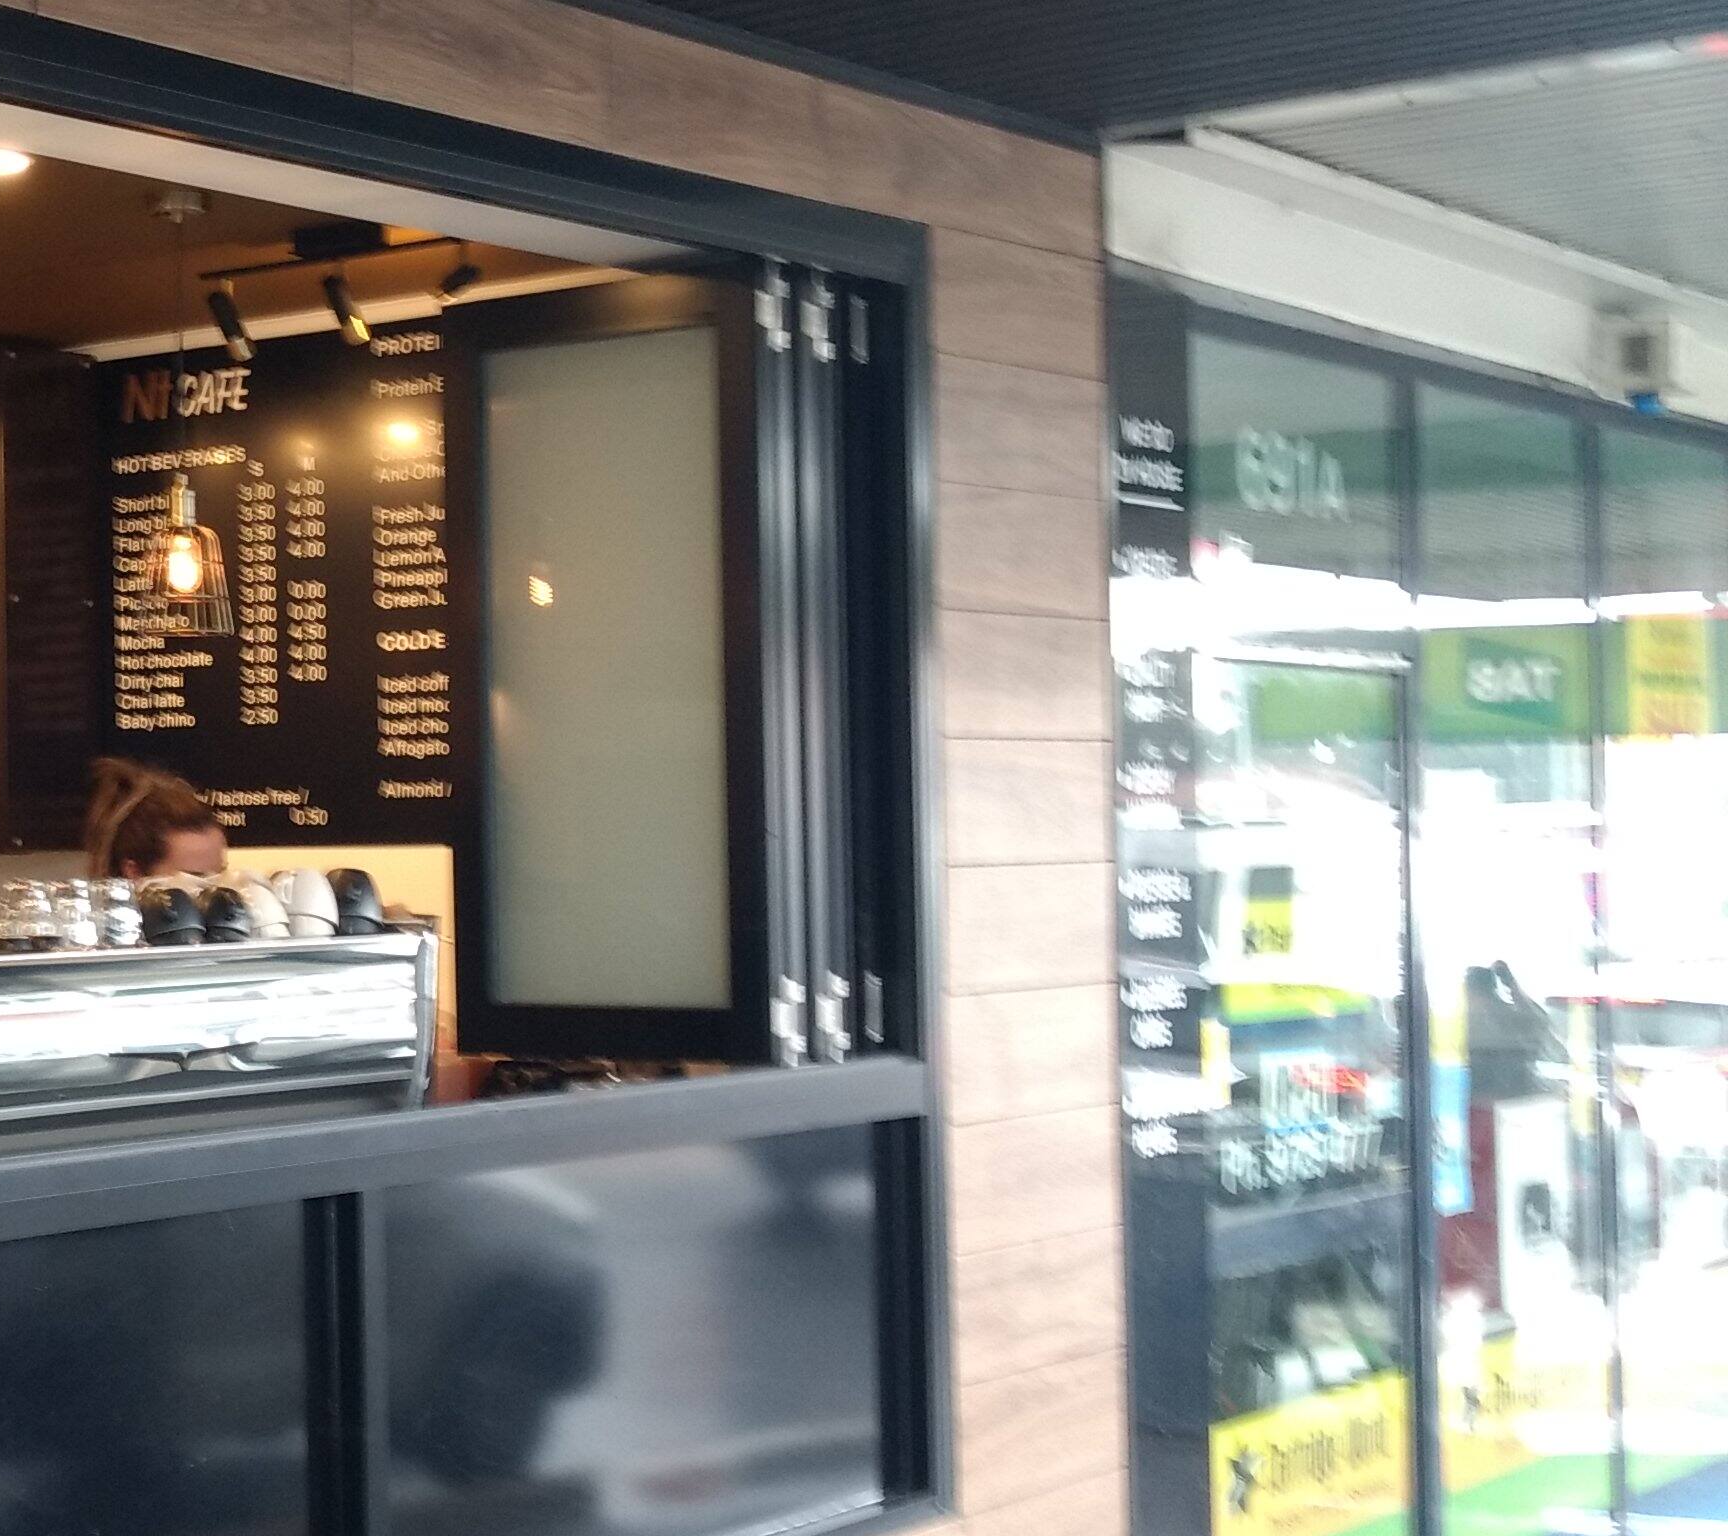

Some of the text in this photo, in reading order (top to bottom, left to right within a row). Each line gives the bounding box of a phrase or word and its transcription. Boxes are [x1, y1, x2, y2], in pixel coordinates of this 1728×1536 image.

[371, 376, 433, 398] Protein
[112, 454, 147, 474] HOT
[113, 494, 154, 514] Short
[237, 483, 275, 501] 3.00
[286, 477, 325, 496] 4.00
[113, 517, 151, 534] Long
[238, 503, 275, 521] 3.50
[286, 499, 325, 517] 4.00
[372, 505, 422, 525] Fresh
[113, 535, 144, 553] Flat
[238, 524, 275, 542] 3.50
[286, 519, 325, 537] 4.00
[373, 527, 436, 546] Orange
[238, 544, 276, 562] 3.50
[286, 539, 325, 558] 4.00
[373, 548, 431, 567] Lemon
[238, 564, 276, 582] 3.50
[238, 584, 276, 602] 3.00
[373, 589, 428, 609] Green
[238, 605, 277, 622] 3.00
[114, 634, 165, 651] Mocha
[239, 625, 277, 643] 4.00
[377, 630, 432, 651] COLD
[115, 643, 326, 670] Hot chocolate 4.00 4.00
[115, 663, 327, 691] Dirty chai 3.50 4.00
[377, 674, 416, 693] Iced
[115, 686, 278, 710] Chai latte 3.50
[377, 695, 416, 714] Iced
[115, 707, 278, 731] Baby chino 2.50
[377, 716, 417, 735] Iced
[217, 790, 269, 806] lactose
[267, 787, 301, 805] free
[377, 778, 443, 799] Almond
[290, 806, 328, 826] 0.50
